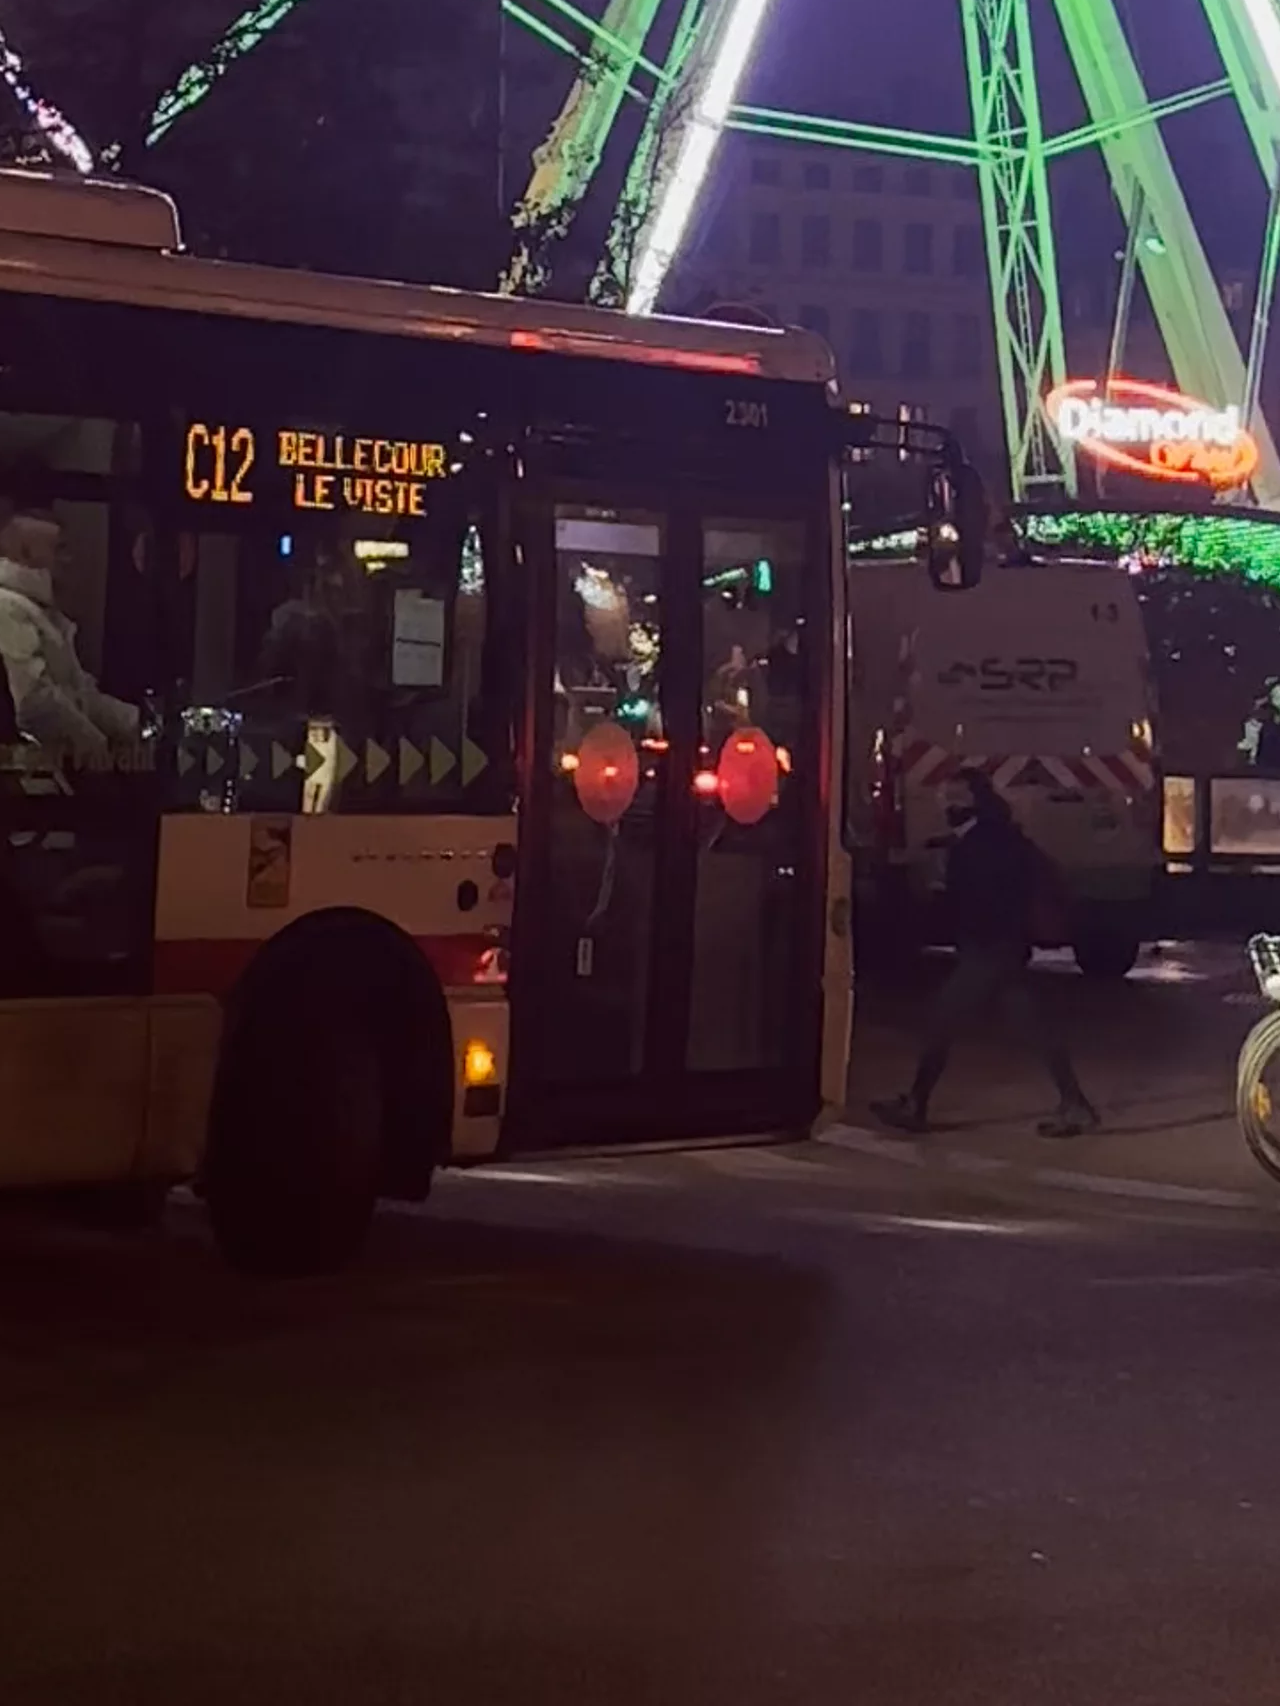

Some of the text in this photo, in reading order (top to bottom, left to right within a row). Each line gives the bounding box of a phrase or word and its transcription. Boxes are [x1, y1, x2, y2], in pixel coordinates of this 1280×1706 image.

[1059, 397, 1238, 445] Diamond
[184, 423, 255, 503] C12
[277, 430, 447, 478] BELLECOUR
[293, 473, 428, 517] LE VISTE
